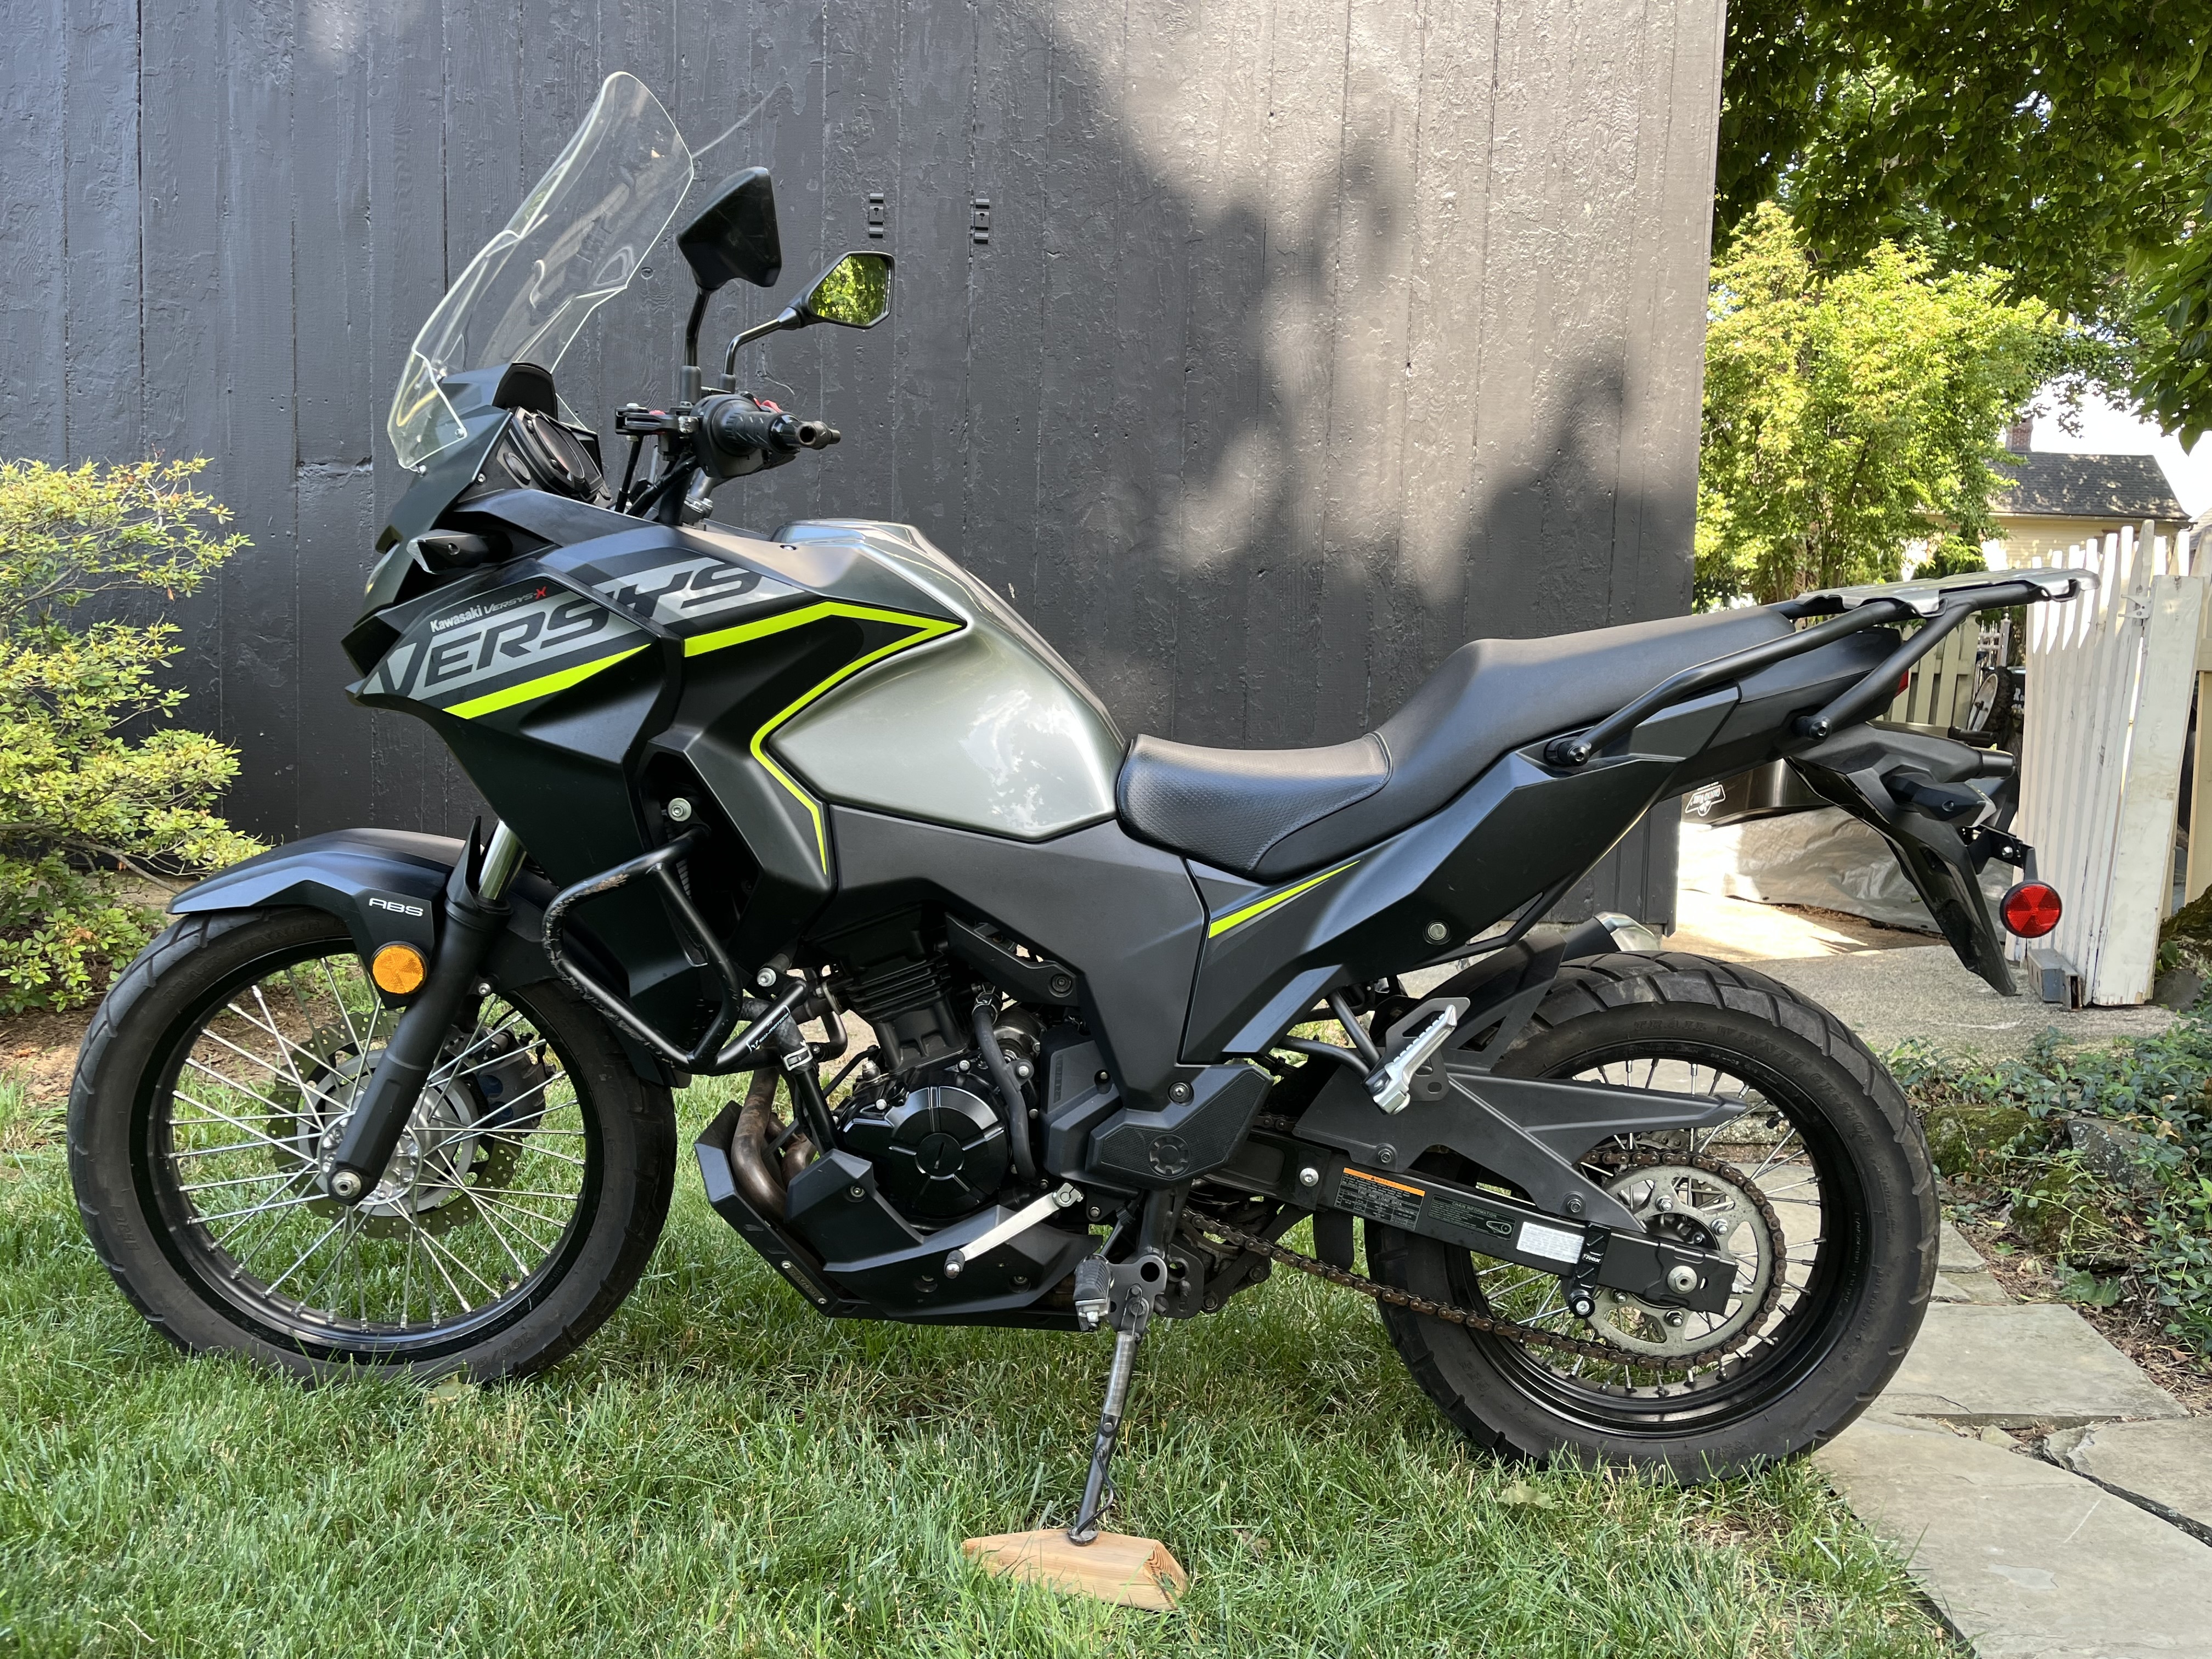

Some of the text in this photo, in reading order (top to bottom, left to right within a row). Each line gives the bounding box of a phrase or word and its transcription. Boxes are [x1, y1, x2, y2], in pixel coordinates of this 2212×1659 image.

[430, 586, 547, 633] Kawasaki VERSYS-X
[369, 898, 424, 917] ABS
[1634, 1019, 1707, 1031] TRAIL
[1717, 1025, 1805, 1068] WINNER
